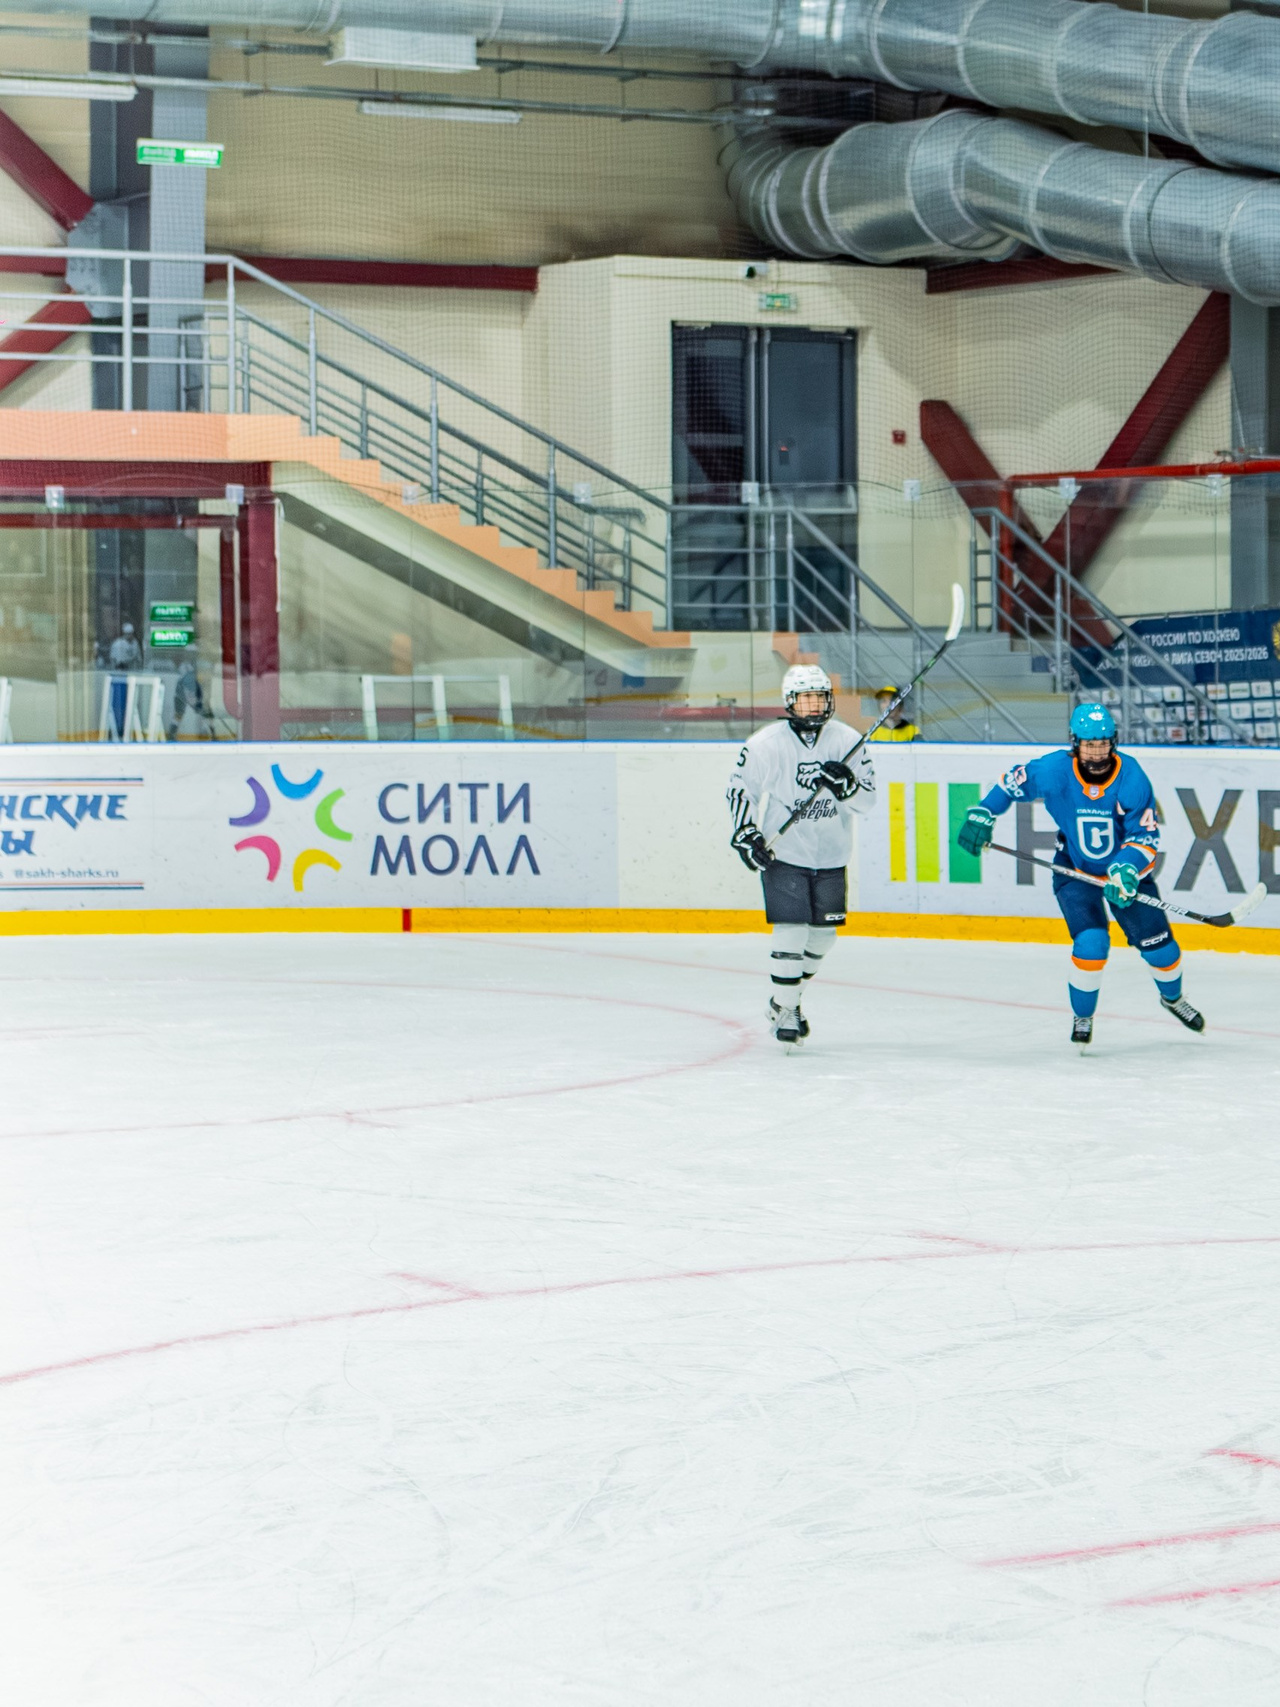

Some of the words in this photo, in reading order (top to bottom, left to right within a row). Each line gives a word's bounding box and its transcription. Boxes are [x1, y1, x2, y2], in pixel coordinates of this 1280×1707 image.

[1188, 631, 1202, 645] ПО
[378, 782, 530, 824] СИТИ
[370, 834, 541, 876] МОЛЛ
[1139, 893, 1189, 917] BAUER
[1140, 930, 1169, 948] CCM
